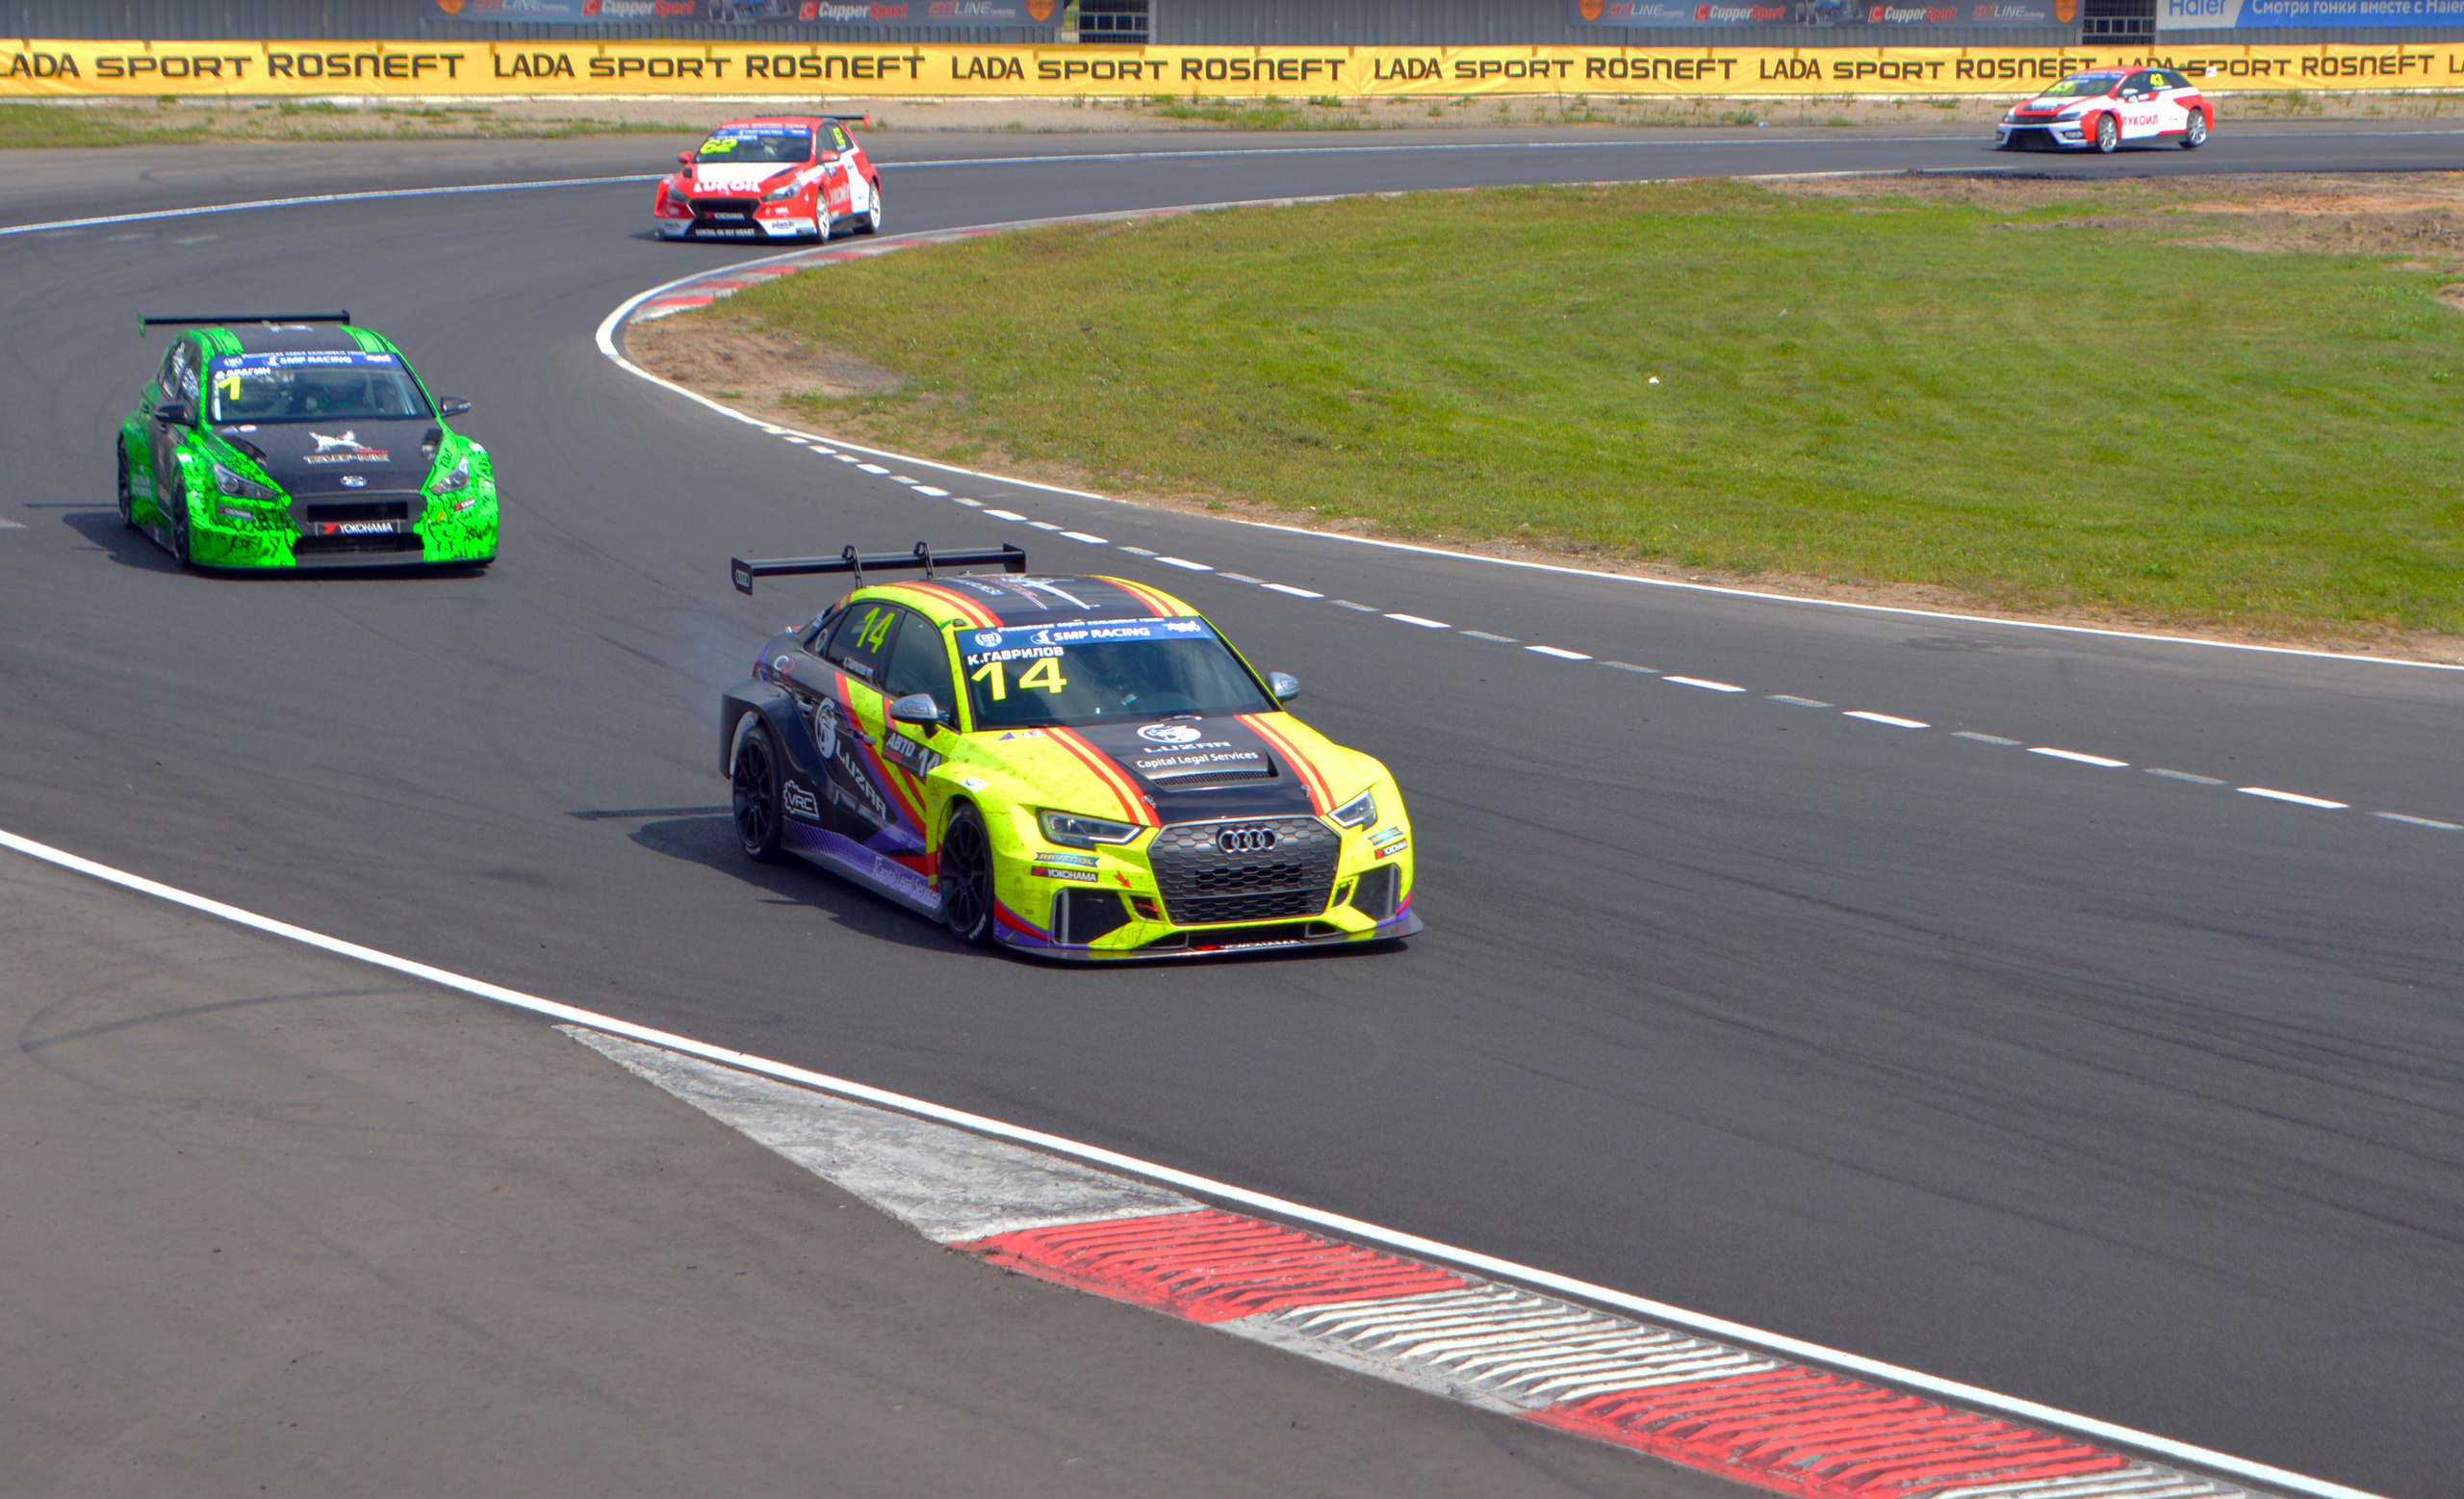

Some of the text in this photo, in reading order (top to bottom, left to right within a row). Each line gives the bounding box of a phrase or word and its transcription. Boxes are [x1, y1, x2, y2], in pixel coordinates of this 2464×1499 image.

[819, 1, 908, 21] CupperSport
[1710, 5, 1784, 21] CupperSport
[1885, 6, 1957, 23] CupperSport
[2252, 0, 2309, 17] Смотри
[2313, 1, 2356, 13] гонки
[2360, 1, 2411, 13] вместе
[0, 53, 81, 78] ADA
[95, 56, 252, 78] SPORT
[268, 53, 465, 78] ROSNEFT
[494, 53, 576, 78] LADA
[589, 56, 732, 78] SPORT
[746, 55, 926, 79] ROSNEFT
[952, 56, 1025, 79] LADA
[1038, 59, 1168, 79] SPORT
[1181, 58, 1346, 80] ROSNEFT
[1373, 58, 1444, 80] LADA
[1454, 60, 1575, 79] SPORT
[1585, 57, 1737, 80] ROSNEFT
[1759, 58, 1822, 80] LADA
[1833, 62, 1945, 79] SPORT
[1956, 57, 2096, 79] ROSNEFT
[2188, 59, 2293, 77] SPORT
[2301, 54, 2435, 77] ROSNEFT
[700, 138, 738, 154] 62
[218, 376, 241, 401] 1
[339, 522, 394, 535] YOKOHAMA
[857, 607, 895, 654] 14
[1053, 627, 1150, 642] SMP RACING
[967, 646, 1065, 665] К.ГАВРИЛОВ
[971, 657, 1067, 701] 14
[886, 733, 916, 758] АВТО
[1136, 751, 1259, 769] Capital Legal Services
[835, 737, 886, 820] LUZAR
[788, 791, 814, 812] VRC
[1040, 853, 1094, 865] RAVENOL
[1047, 868, 1097, 882] YOKOHAMA
